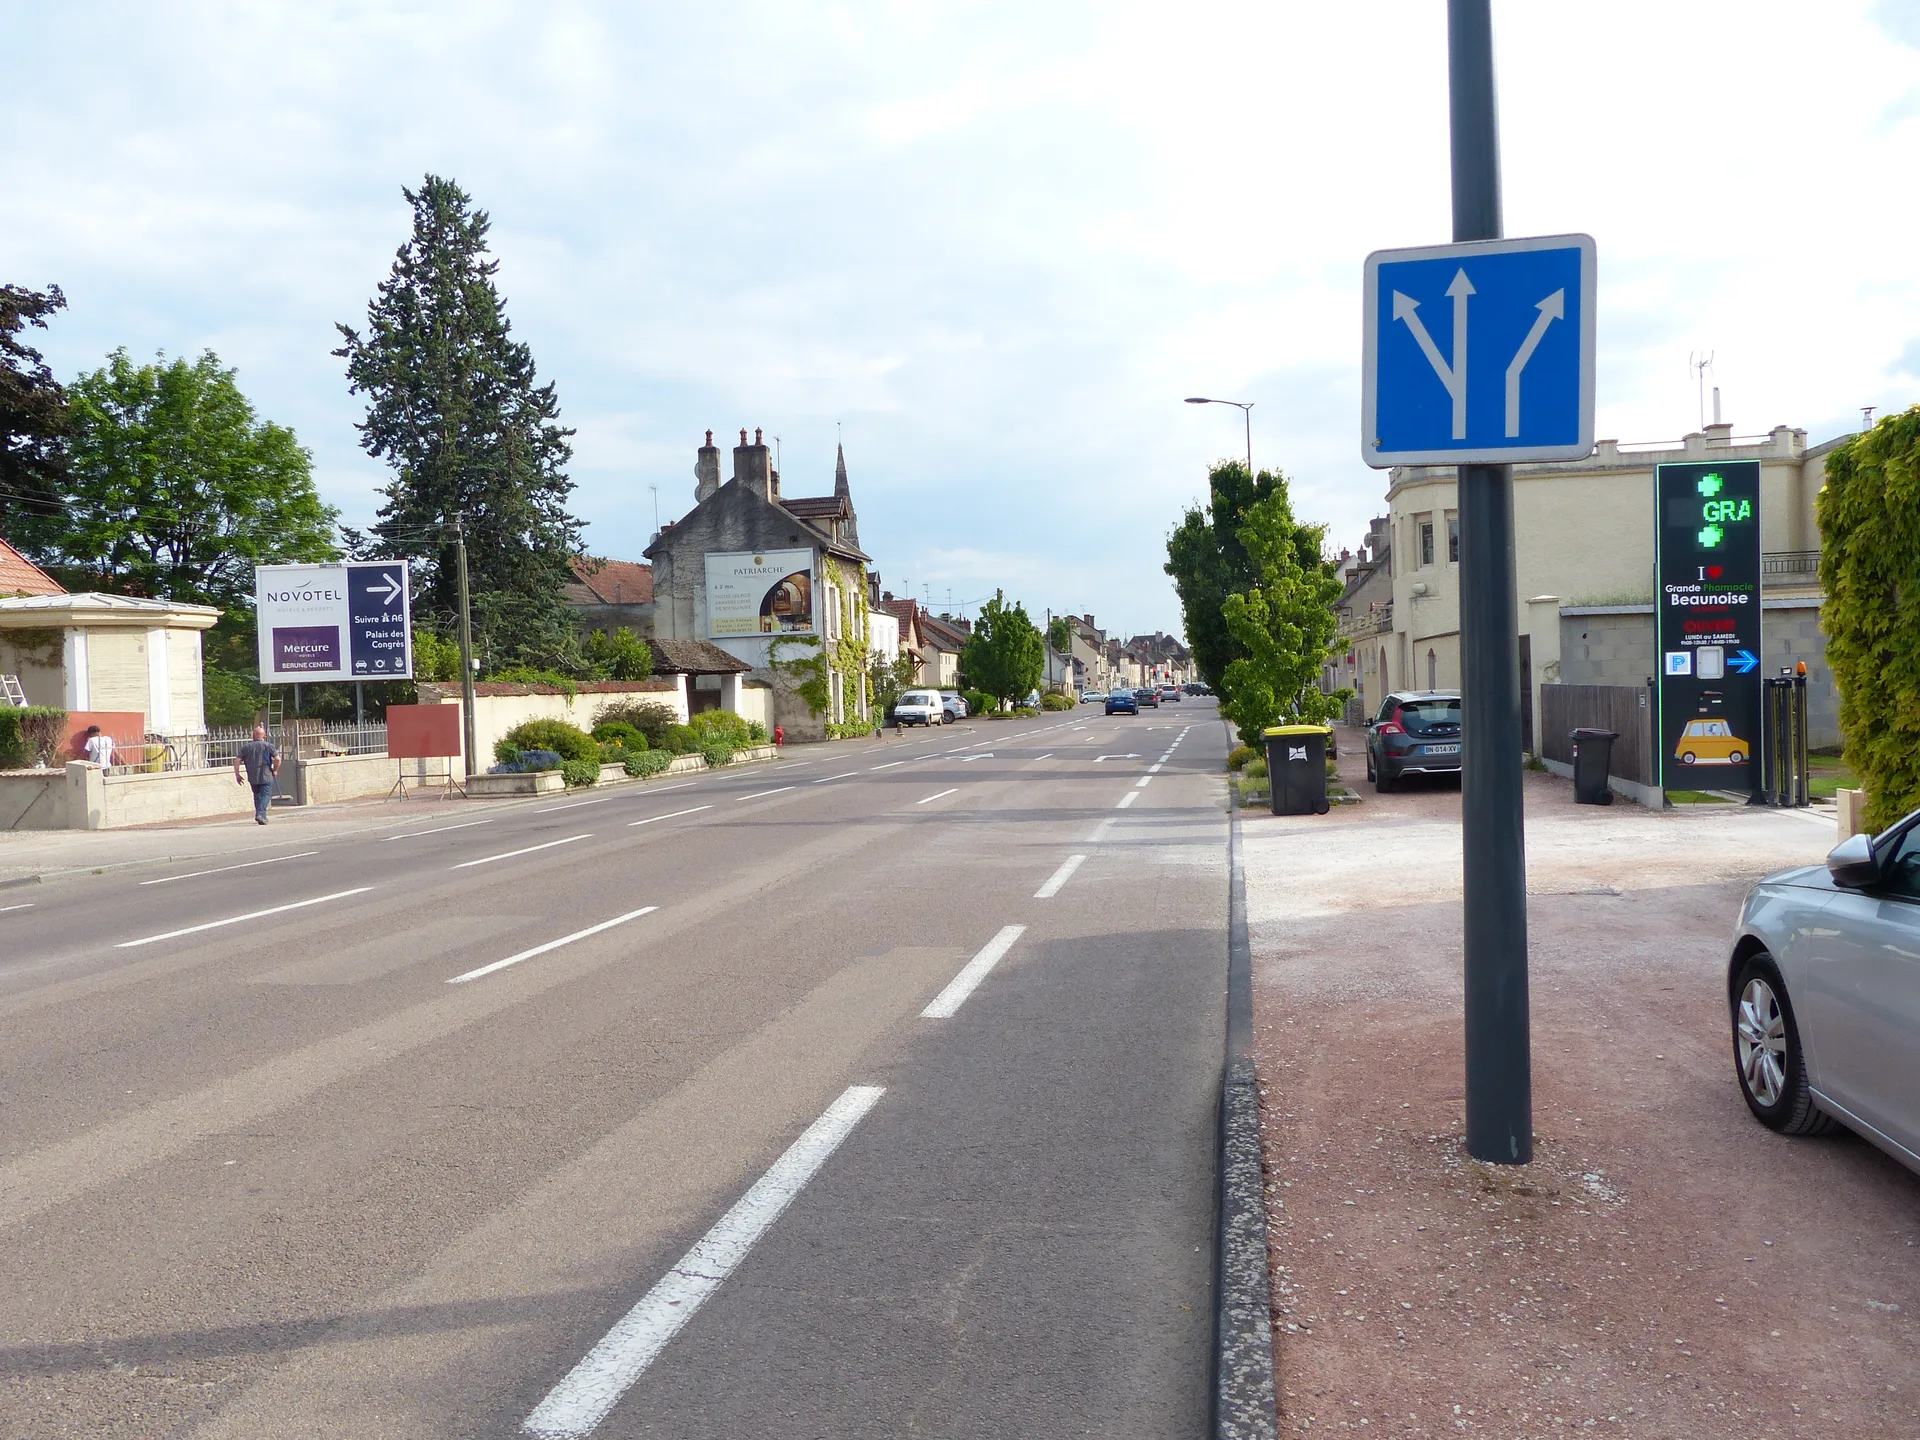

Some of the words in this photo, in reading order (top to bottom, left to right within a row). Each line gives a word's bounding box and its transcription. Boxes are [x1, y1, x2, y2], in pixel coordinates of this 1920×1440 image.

[1703, 499, 1751, 522] GRA
[734, 567, 784, 575] PATRIARCHE
[1697, 566, 1706, 581] I
[1665, 584, 1701, 593] Grande
[1703, 582, 1754, 592] Pharmacie
[267, 590, 342, 603] NOVOTEL
[1671, 592, 1749, 606] Beaunoise
[354, 615, 379, 624] Suivre
[391, 614, 404, 622] A6
[1683, 619, 1737, 633] OUVERT
[365, 630, 389, 639] Palais
[390, 630, 404, 638] des
[284, 643, 330, 654] Mercure
[372, 640, 405, 650] Congrès
